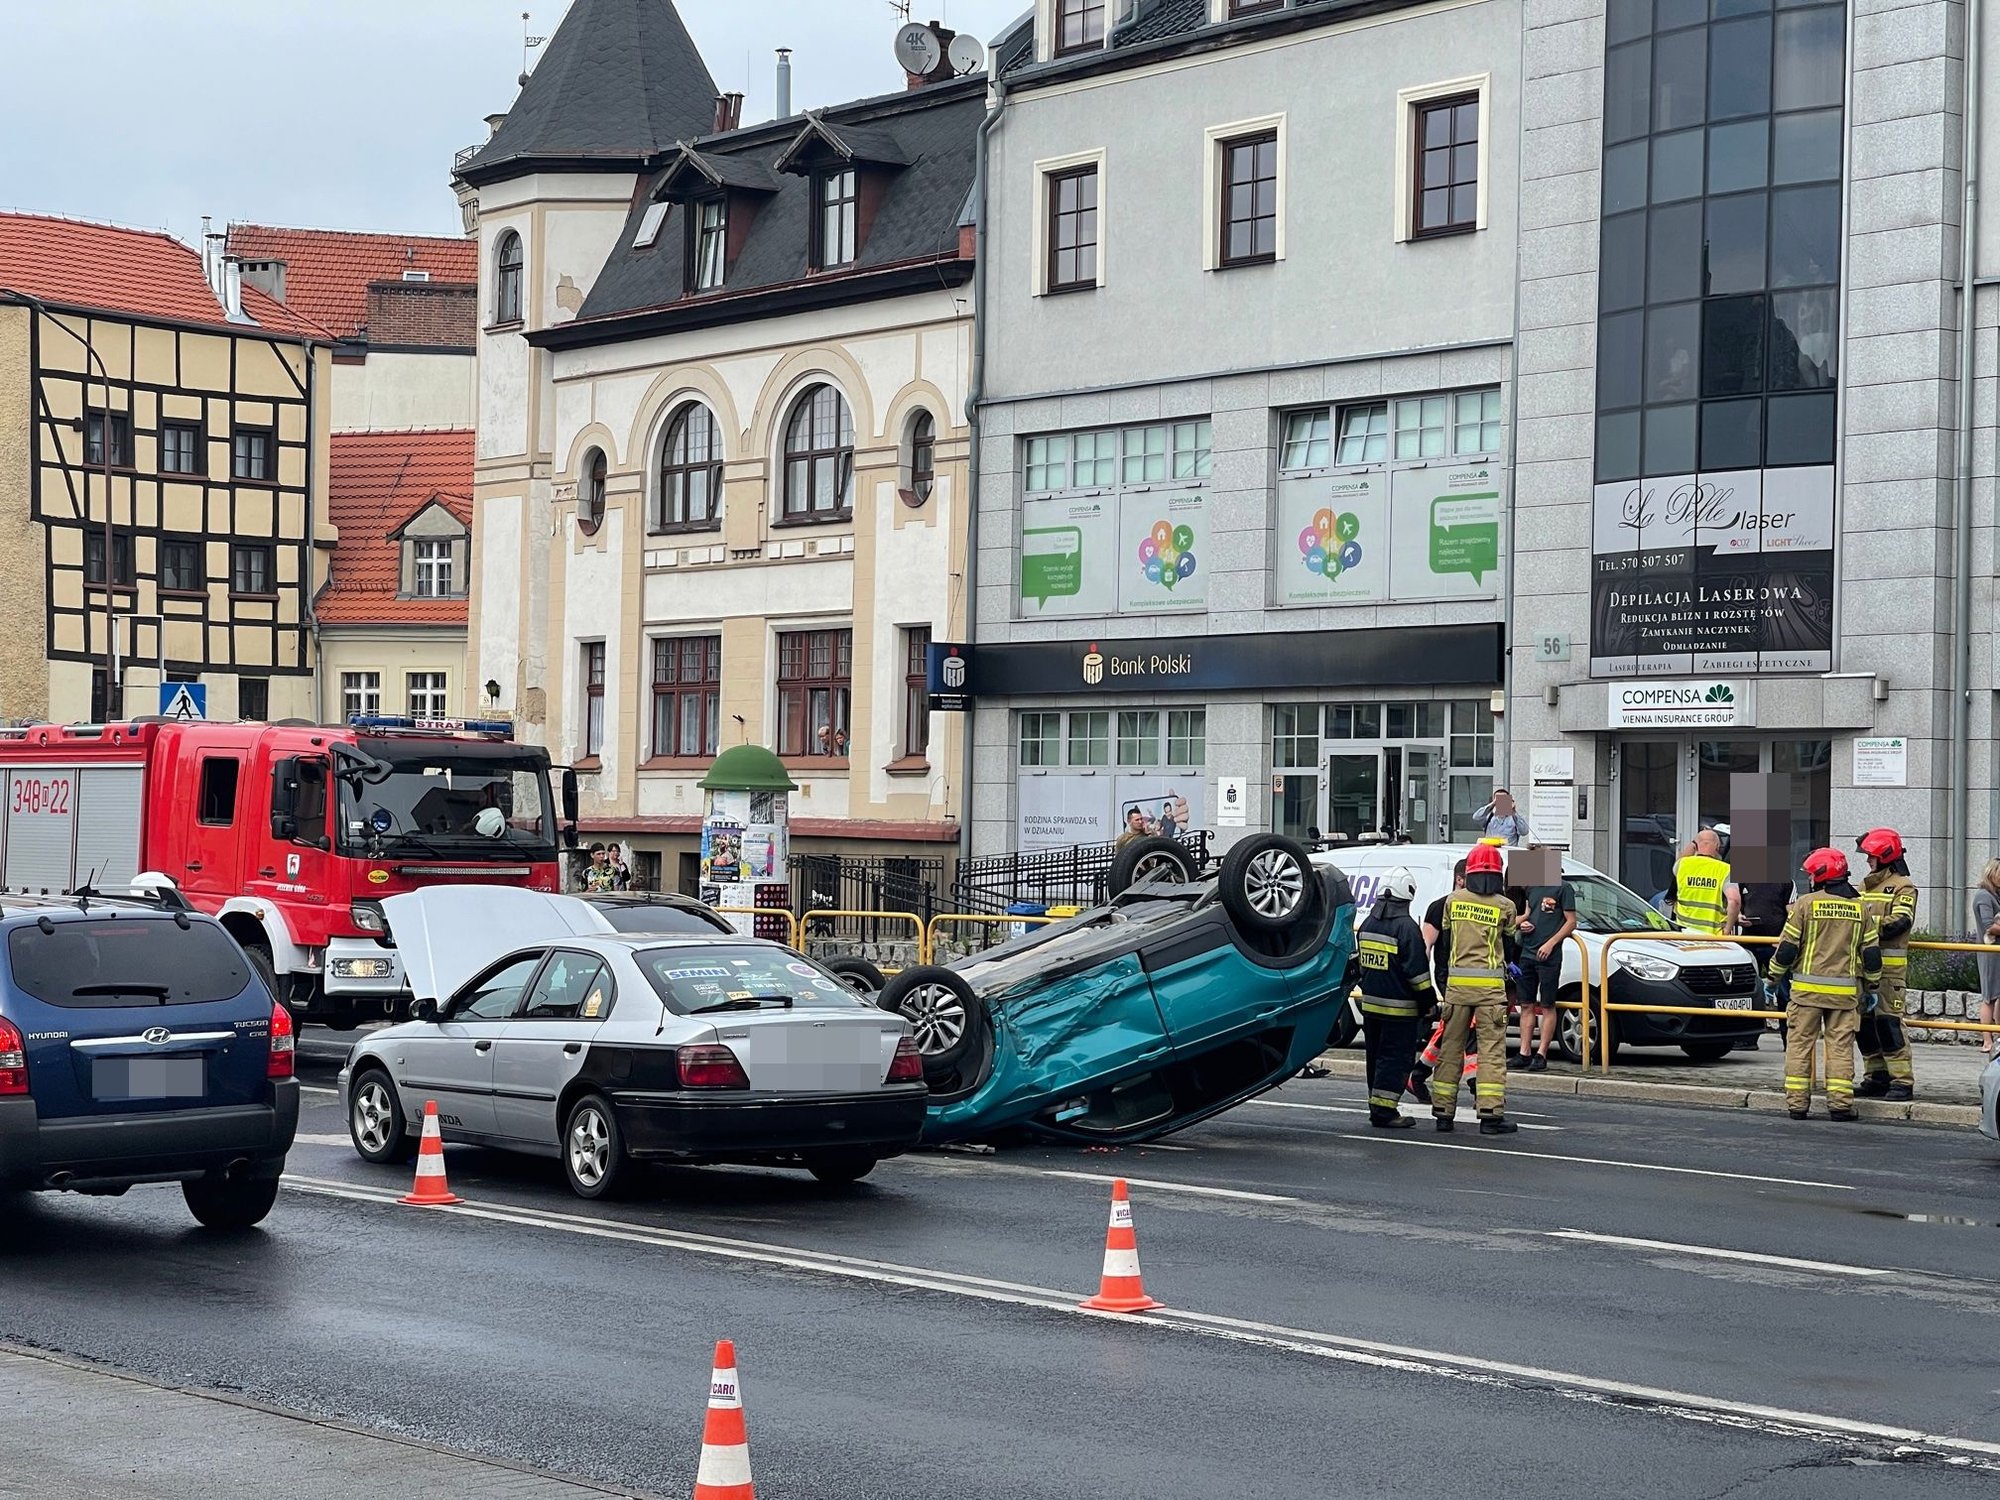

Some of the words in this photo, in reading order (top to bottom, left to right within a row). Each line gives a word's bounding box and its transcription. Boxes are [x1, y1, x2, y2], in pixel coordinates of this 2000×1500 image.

[905, 32, 926, 46] 4K
[1448, 472, 1477, 481] COMPENSA
[1331, 483, 1359, 492] COMPENSA
[1617, 487, 1655, 529] La
[1665, 483, 1740, 537] Pelle
[1740, 510, 1796, 531] laser
[1621, 556, 1638, 570] 570
[1641, 555, 1661, 568] 507
[1664, 553, 1685, 566] 507
[1544, 637, 1560, 655] 56
[1111, 656, 1146, 676] Bank
[1151, 653, 1192, 675] Polski
[1622, 689, 1702, 705] COMPENSA
[1623, 714, 1652, 724] VIENNA
[1654, 714, 1702, 723] INSURANCE
[1704, 713, 1734, 723] GROUP
[1024, 816, 1051, 826] RODZINA
[1053, 815, 1087, 826] SPRAWDZA
[1088, 815, 1098, 827] SIĘ
[1024, 826, 1031, 835] W
[1687, 876, 1718, 888] VICARO
[668, 967, 728, 979] SEMIN
[1717, 999, 1726, 1010] SK
[1728, 998, 1751, 1010] 604PU
[28, 1031, 69, 1040] HYUNDAI
